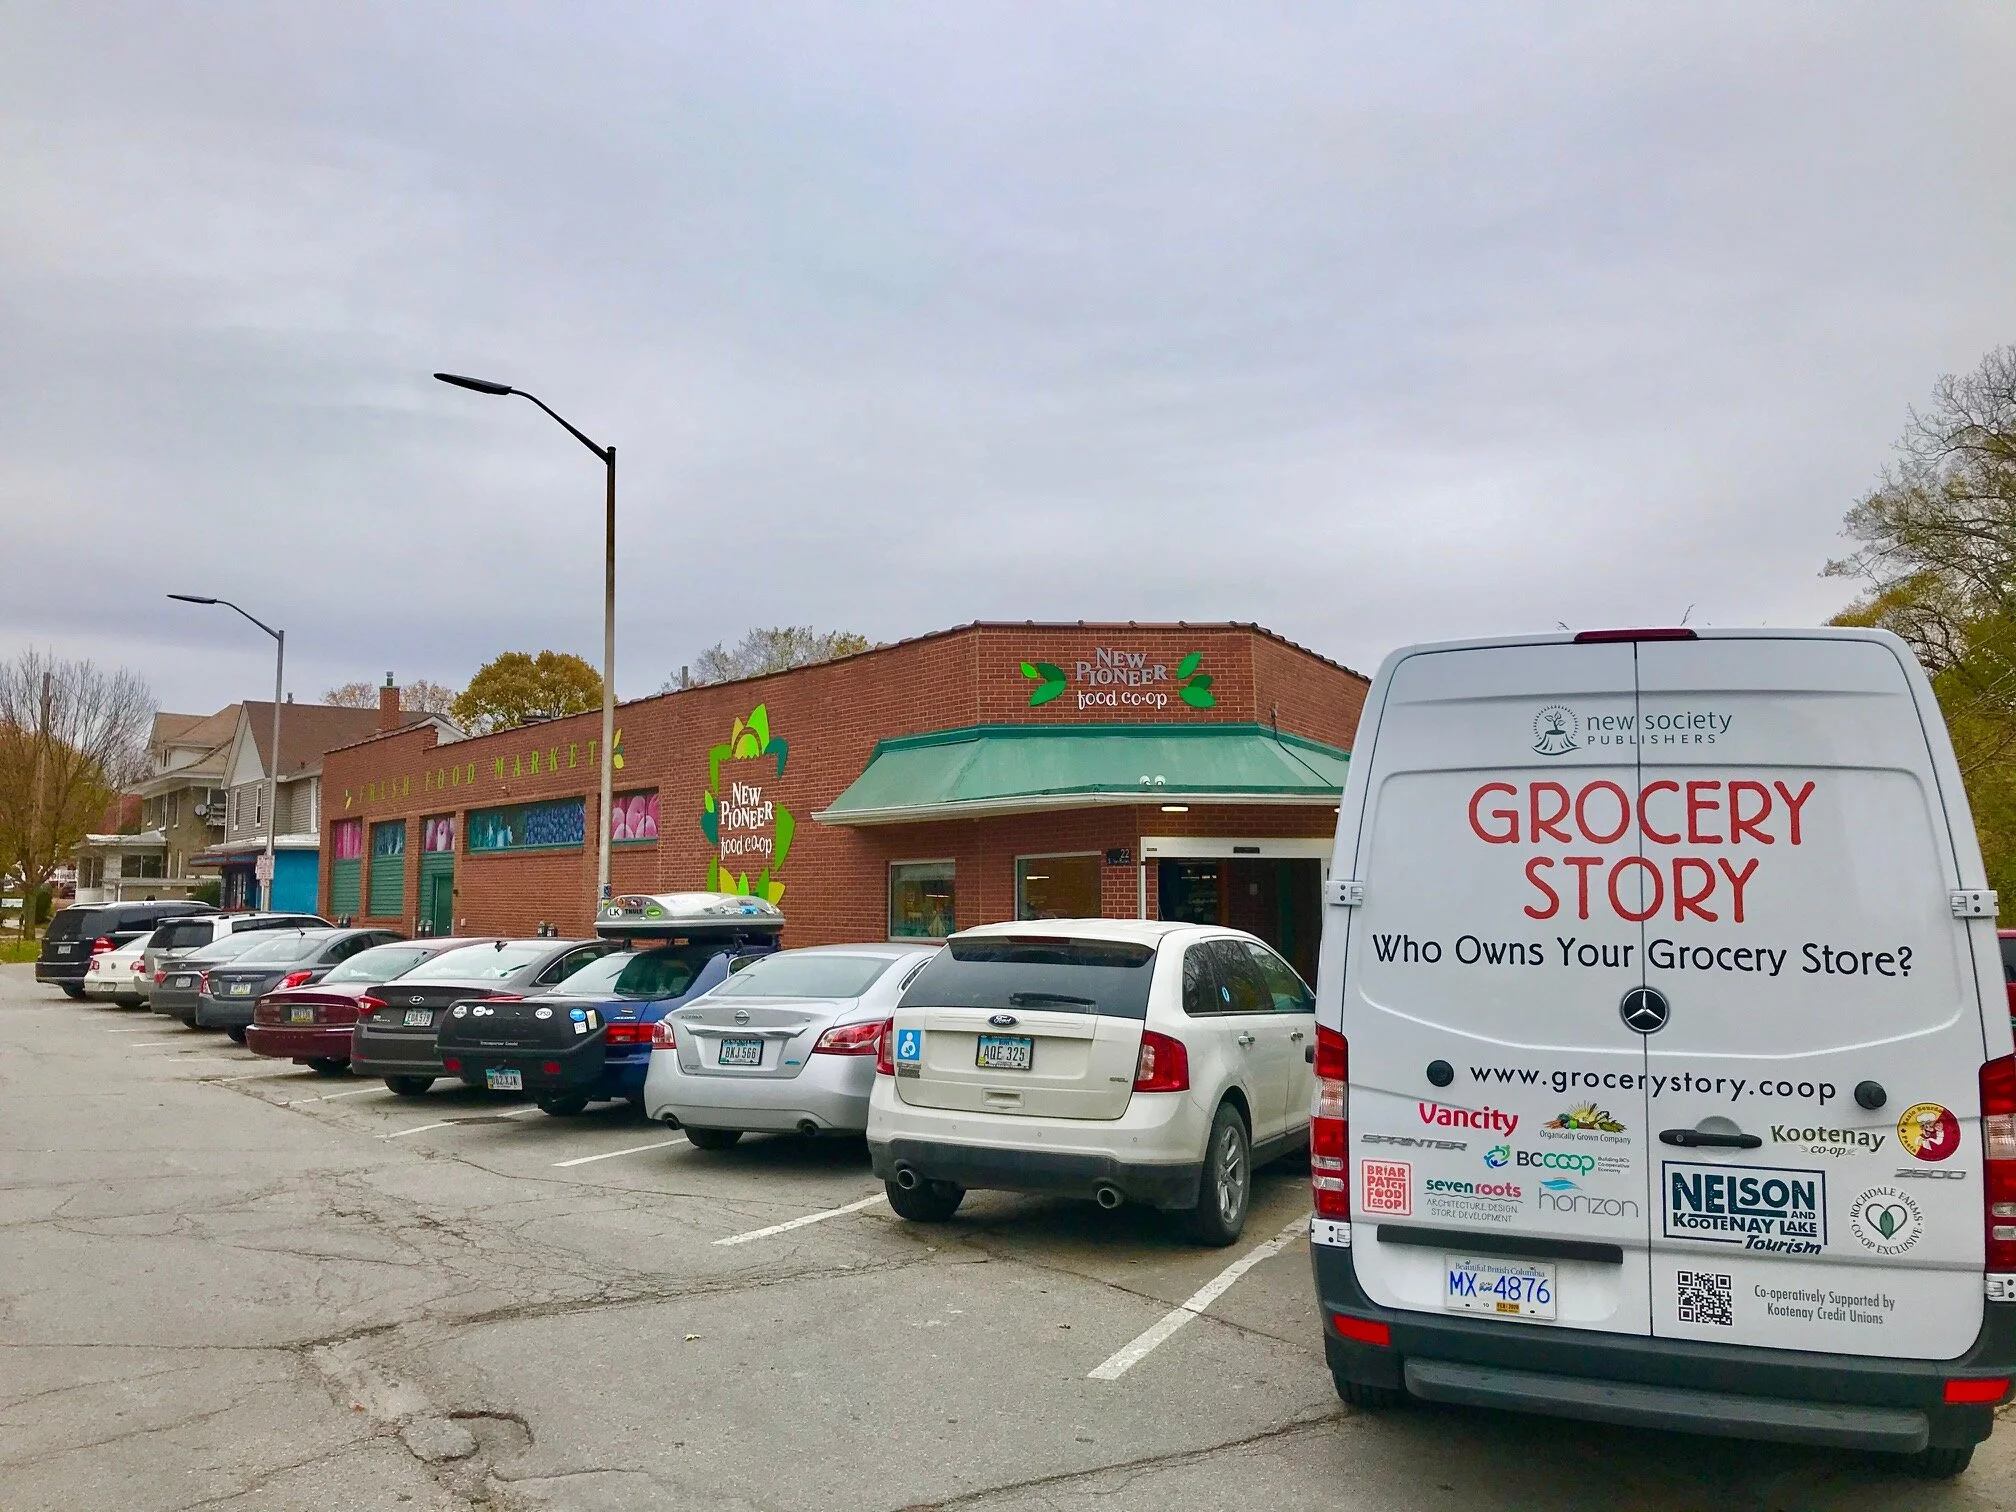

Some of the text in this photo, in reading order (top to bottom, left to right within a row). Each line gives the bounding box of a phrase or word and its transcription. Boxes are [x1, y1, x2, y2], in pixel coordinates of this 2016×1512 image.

[1095, 647, 1147, 669] NEW
[1075, 661, 1168, 687] PIONEER
[1077, 690, 1118, 710] food
[1587, 711, 1733, 734] new society
[1587, 733, 1716, 745] PUBLISHERS
[425, 763, 476, 792] FOOD
[495, 740, 598, 779] MARKET
[732, 781, 762, 809] NEW
[720, 800, 774, 831] PIONEER
[1468, 780, 1816, 845] GROCERY
[720, 834, 743, 861] food
[1120, 848, 1130, 859] 22
[1523, 856, 1760, 923] STORY
[609, 908, 620, 916] LK
[1372, 934, 1913, 977] Who Owns Your Grocery Store?
[992, 1015, 1012, 1024] Ford
[984, 1045, 1025, 1062] AQE 325
[1470, 1065, 1836, 1105] www.grocerystory.coop
[1418, 1102, 1519, 1138] Vancity
[1360, 1133, 1468, 1152] SPRINTER
[1539, 1129, 1632, 1145] Organically Grown Company
[1770, 1124, 1886, 1153] Kootenay
[1810, 1145, 1847, 1158] co-op
[1367, 1175, 1406, 1189] PATCH
[1893, 1168, 1967, 1180] 2500
[1367, 1187, 1402, 1200] FOOD
[1426, 1179, 1522, 1198] seven roots
[1671, 1172, 1816, 1218] NELSON
[1538, 1187, 1639, 1218] horizon
[1850, 1186, 1923, 1222] ROCHDALE FARMS
[1431, 1208, 1513, 1223] STORE DEVELOPMENT
[1672, 1212, 1818, 1238] KOOTENAY LAKE
[1791, 1211, 1816, 1220] AND
[1745, 1234, 1822, 1255] Tourism
[1876, 1227, 1923, 1255] EXCLUSIVE
[1455, 1261, 1546, 1278] Beautiful British Columbia
[1450, 1271, 1551, 1304] MX 4876
[1754, 1284, 1896, 1311] Co-operatively Supported by
[1767, 1302, 1884, 1325] Kootenay Credit Unions
